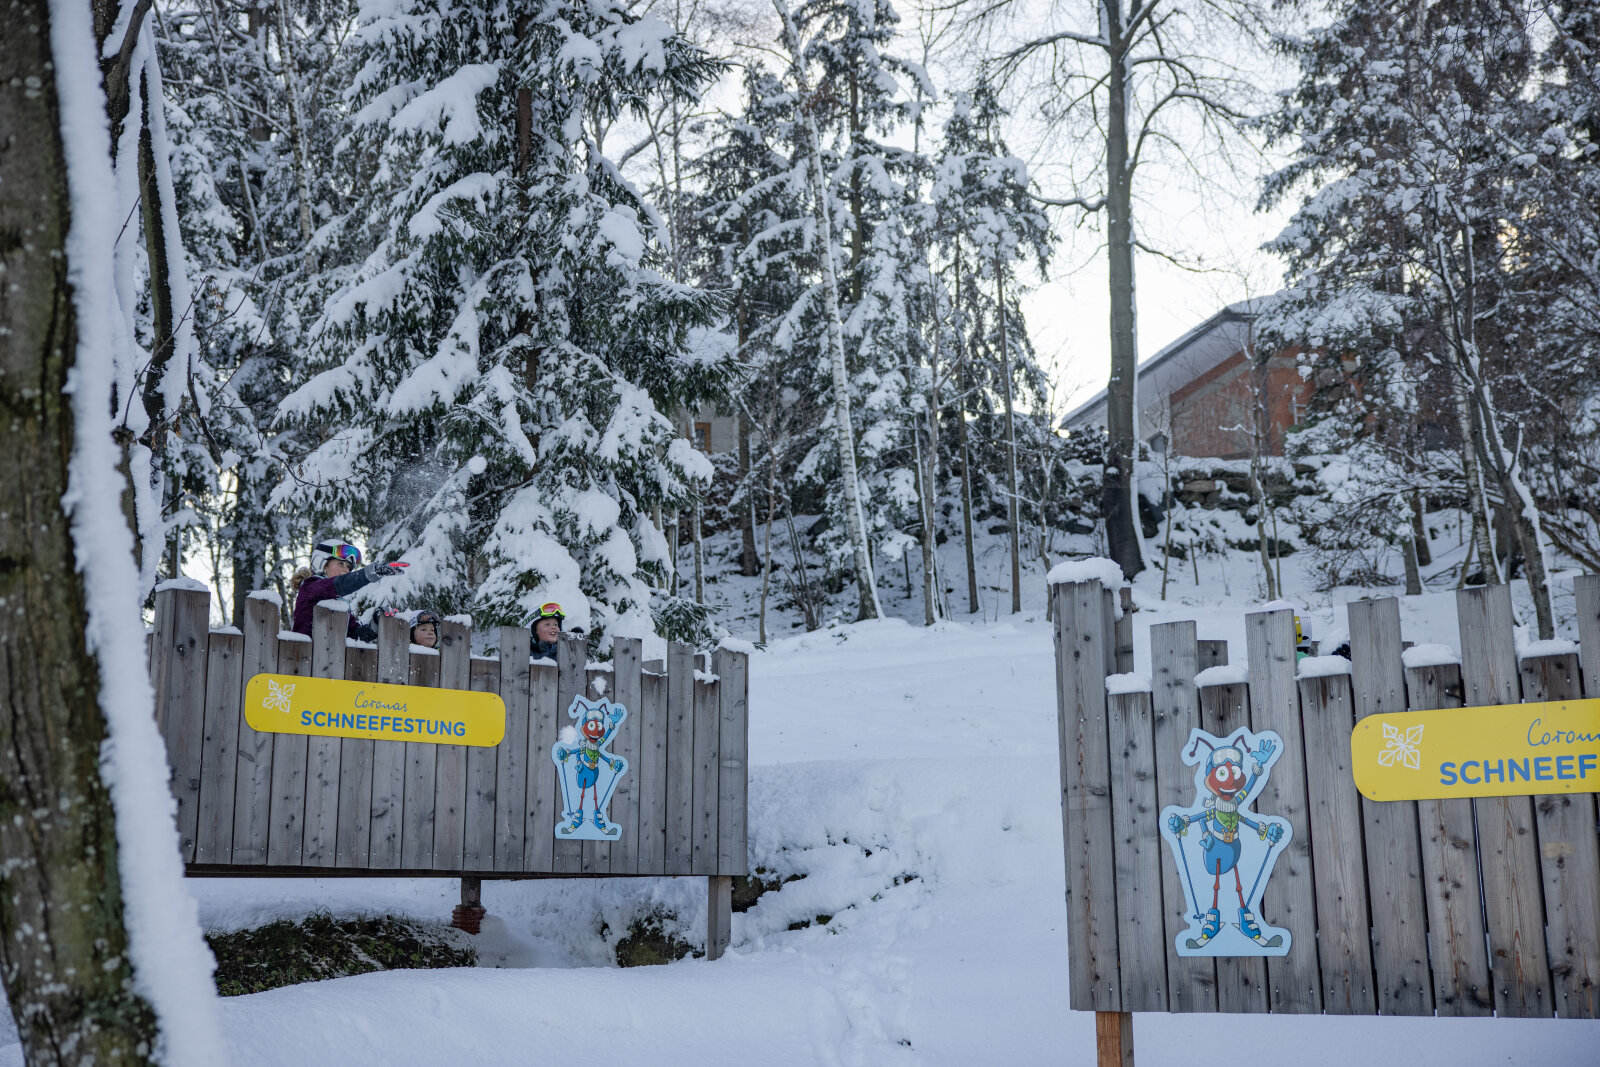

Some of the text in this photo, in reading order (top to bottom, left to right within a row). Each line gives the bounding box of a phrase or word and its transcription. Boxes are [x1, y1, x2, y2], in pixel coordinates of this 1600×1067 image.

[300, 710, 466, 737] SCHNEEFESTUNG
[1527, 718, 1600, 747] Coron
[1439, 754, 1598, 786] SCHNEEF
